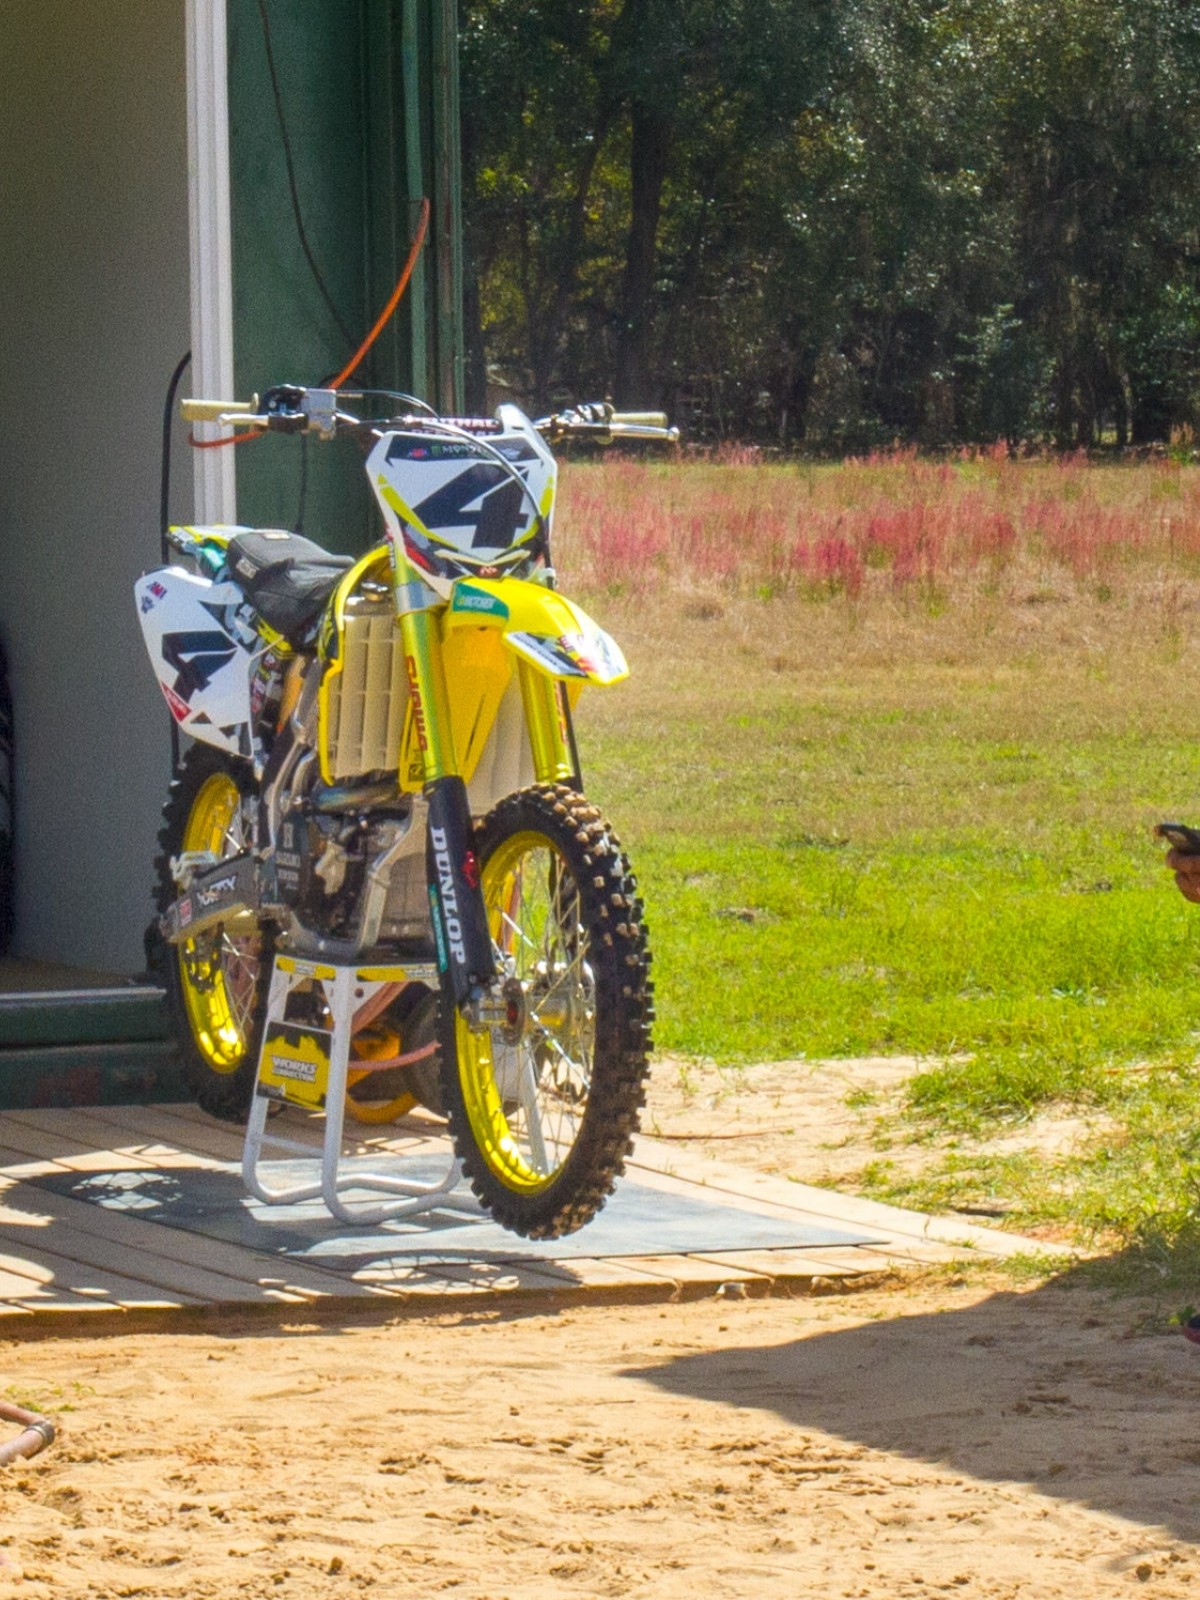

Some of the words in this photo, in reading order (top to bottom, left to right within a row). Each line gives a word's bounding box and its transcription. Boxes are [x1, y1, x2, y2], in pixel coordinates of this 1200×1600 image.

[412, 462, 530, 549] 4
[161, 630, 240, 705] 4
[430, 826, 466, 964] DUNLOP
[272, 1055, 318, 1074] WORKS
